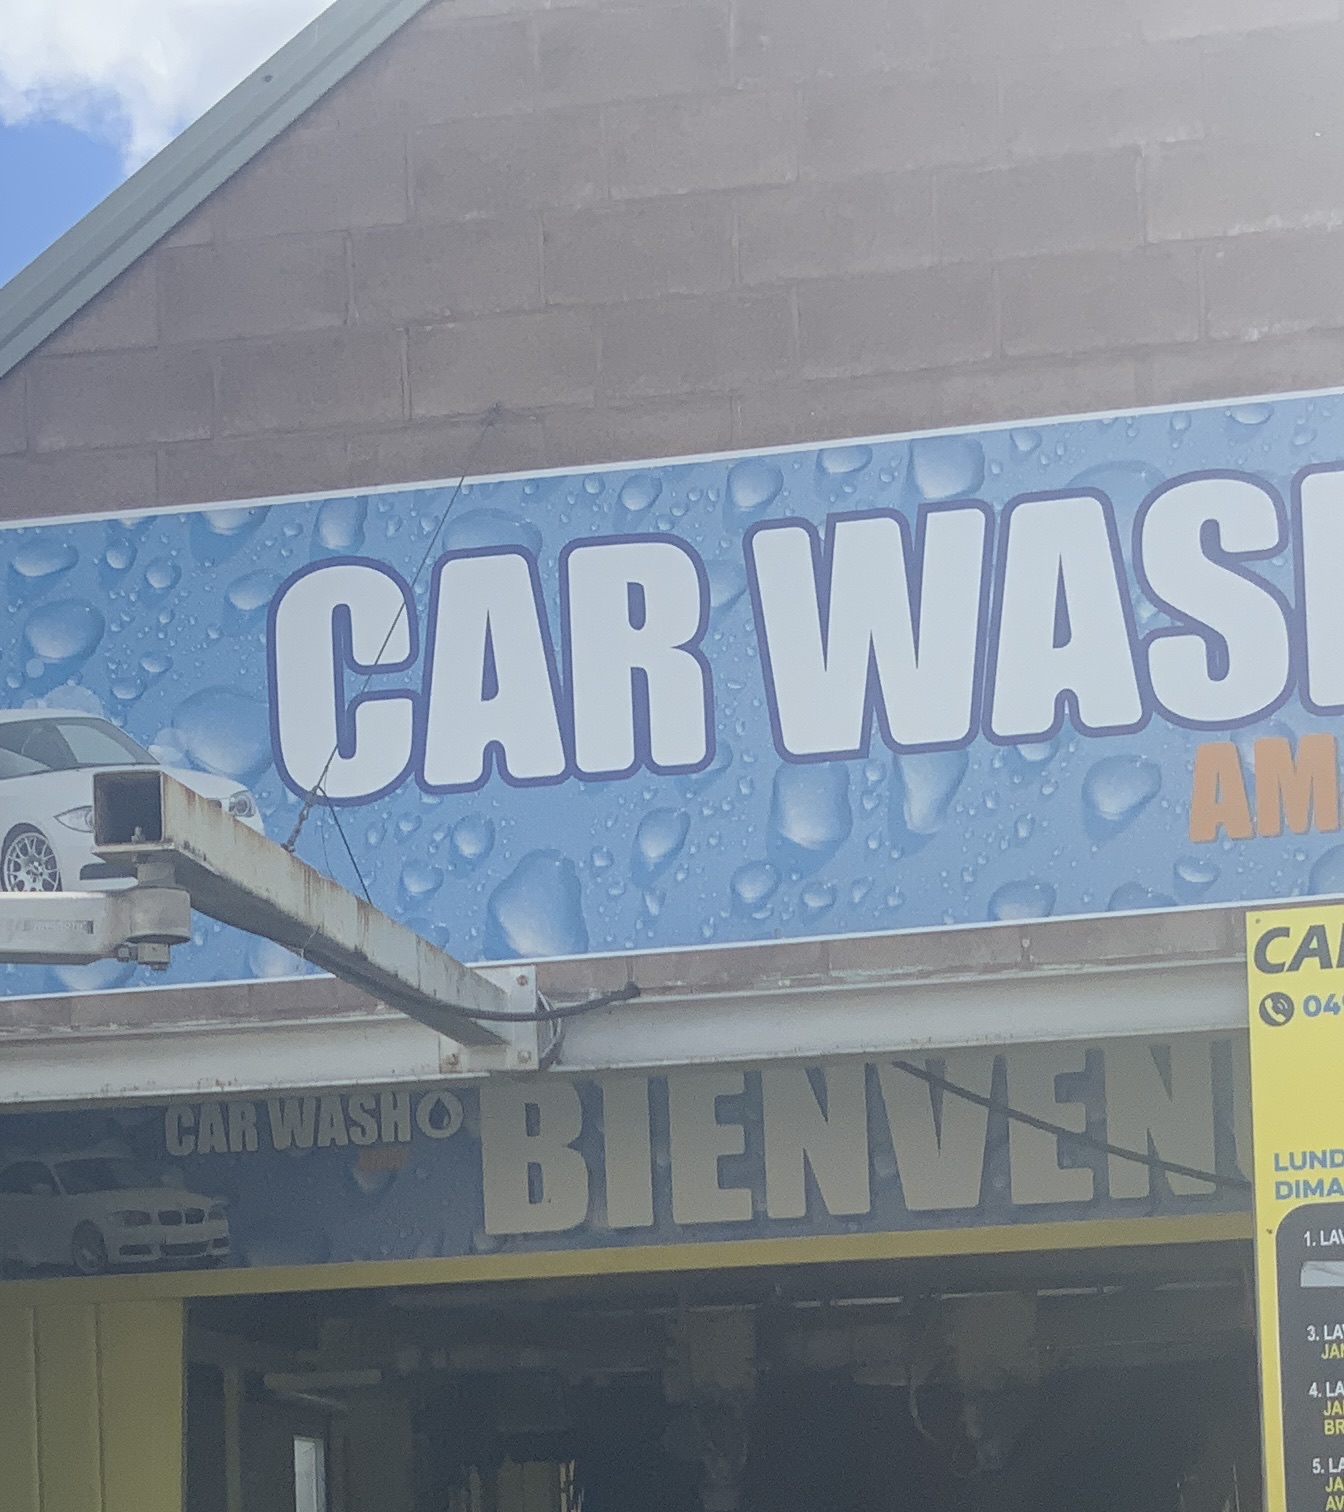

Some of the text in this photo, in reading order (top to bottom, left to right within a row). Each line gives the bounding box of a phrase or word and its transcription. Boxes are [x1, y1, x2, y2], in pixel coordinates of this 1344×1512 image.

[270, 534, 716, 804] CAR
[165, 1092, 411, 1156] CAR WASH
